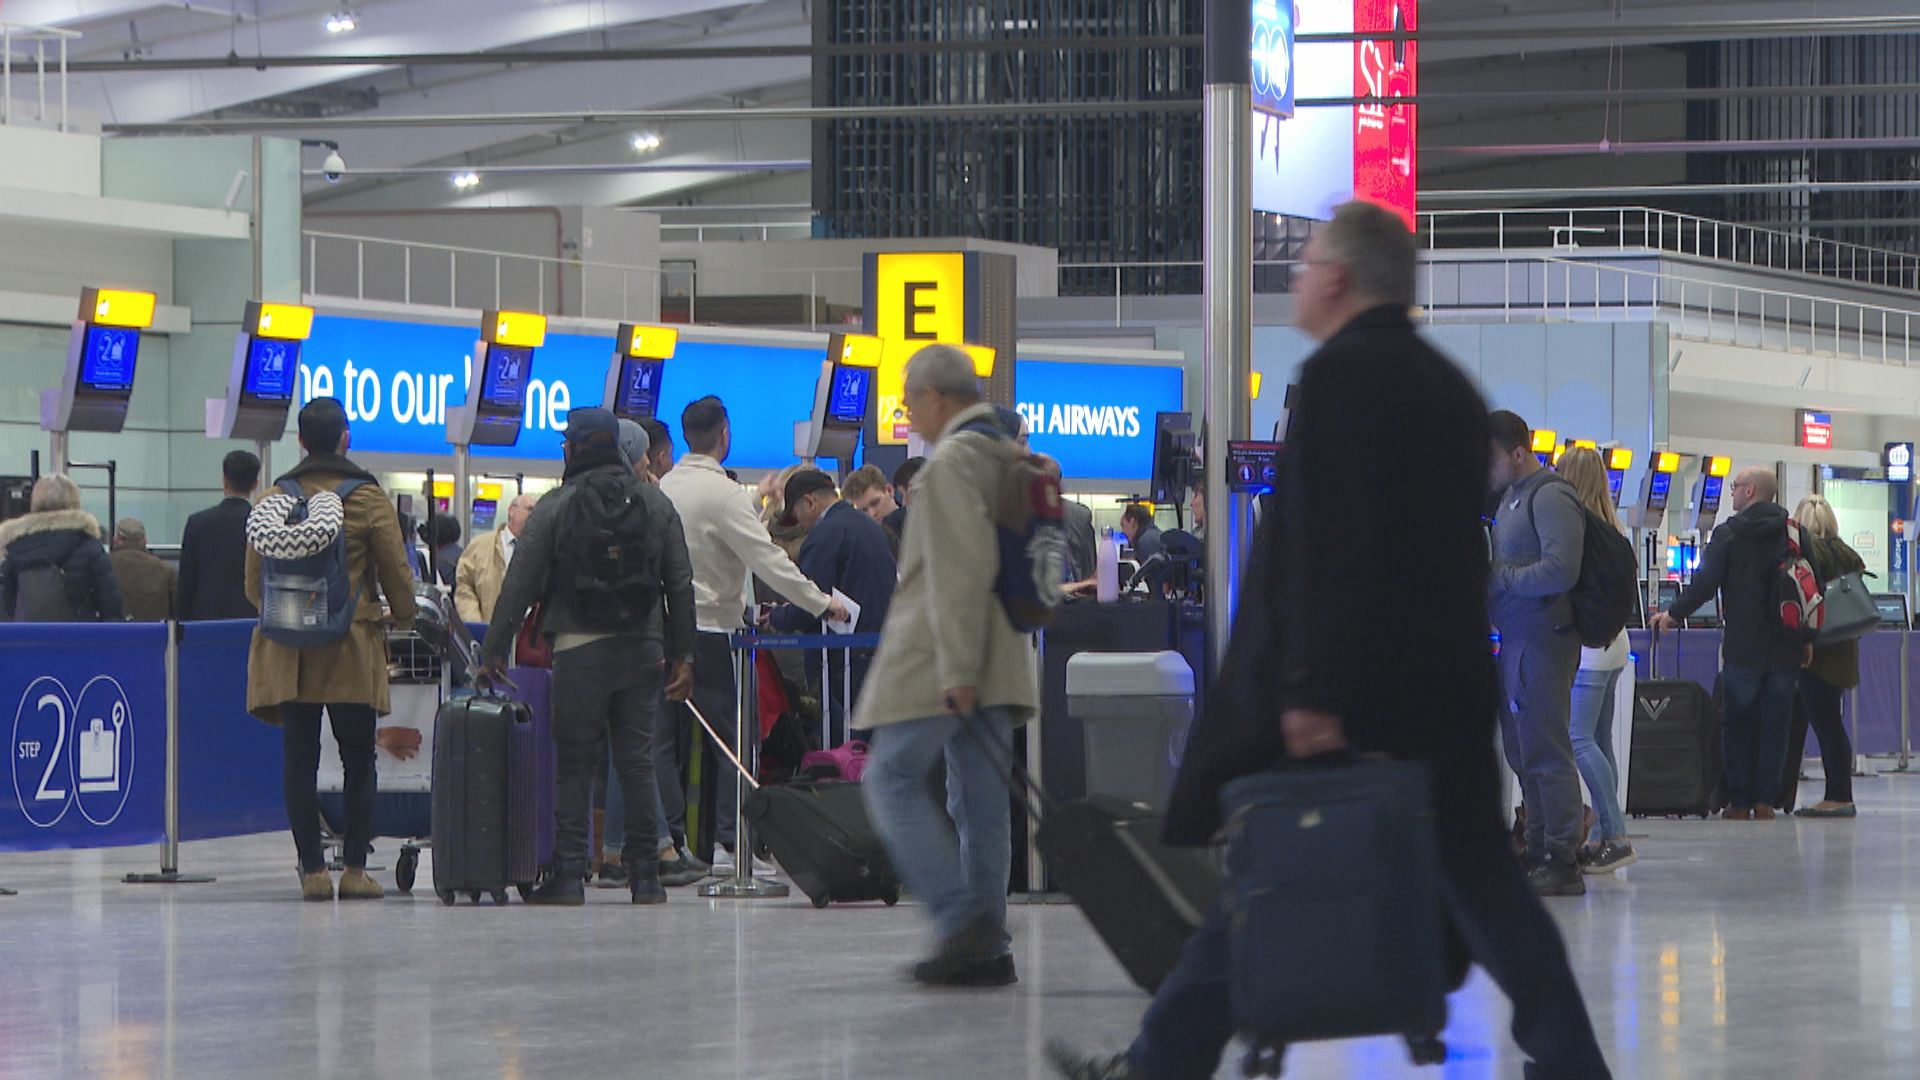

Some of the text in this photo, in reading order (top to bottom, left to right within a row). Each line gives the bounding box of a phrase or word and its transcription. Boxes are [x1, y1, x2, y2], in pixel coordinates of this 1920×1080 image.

[904, 281, 938, 341] E
[344, 360, 381, 422] to
[391, 370, 453, 425] our
[1048, 404, 1140, 437] AIRWAYS
[19, 694, 66, 800] STEP 2
